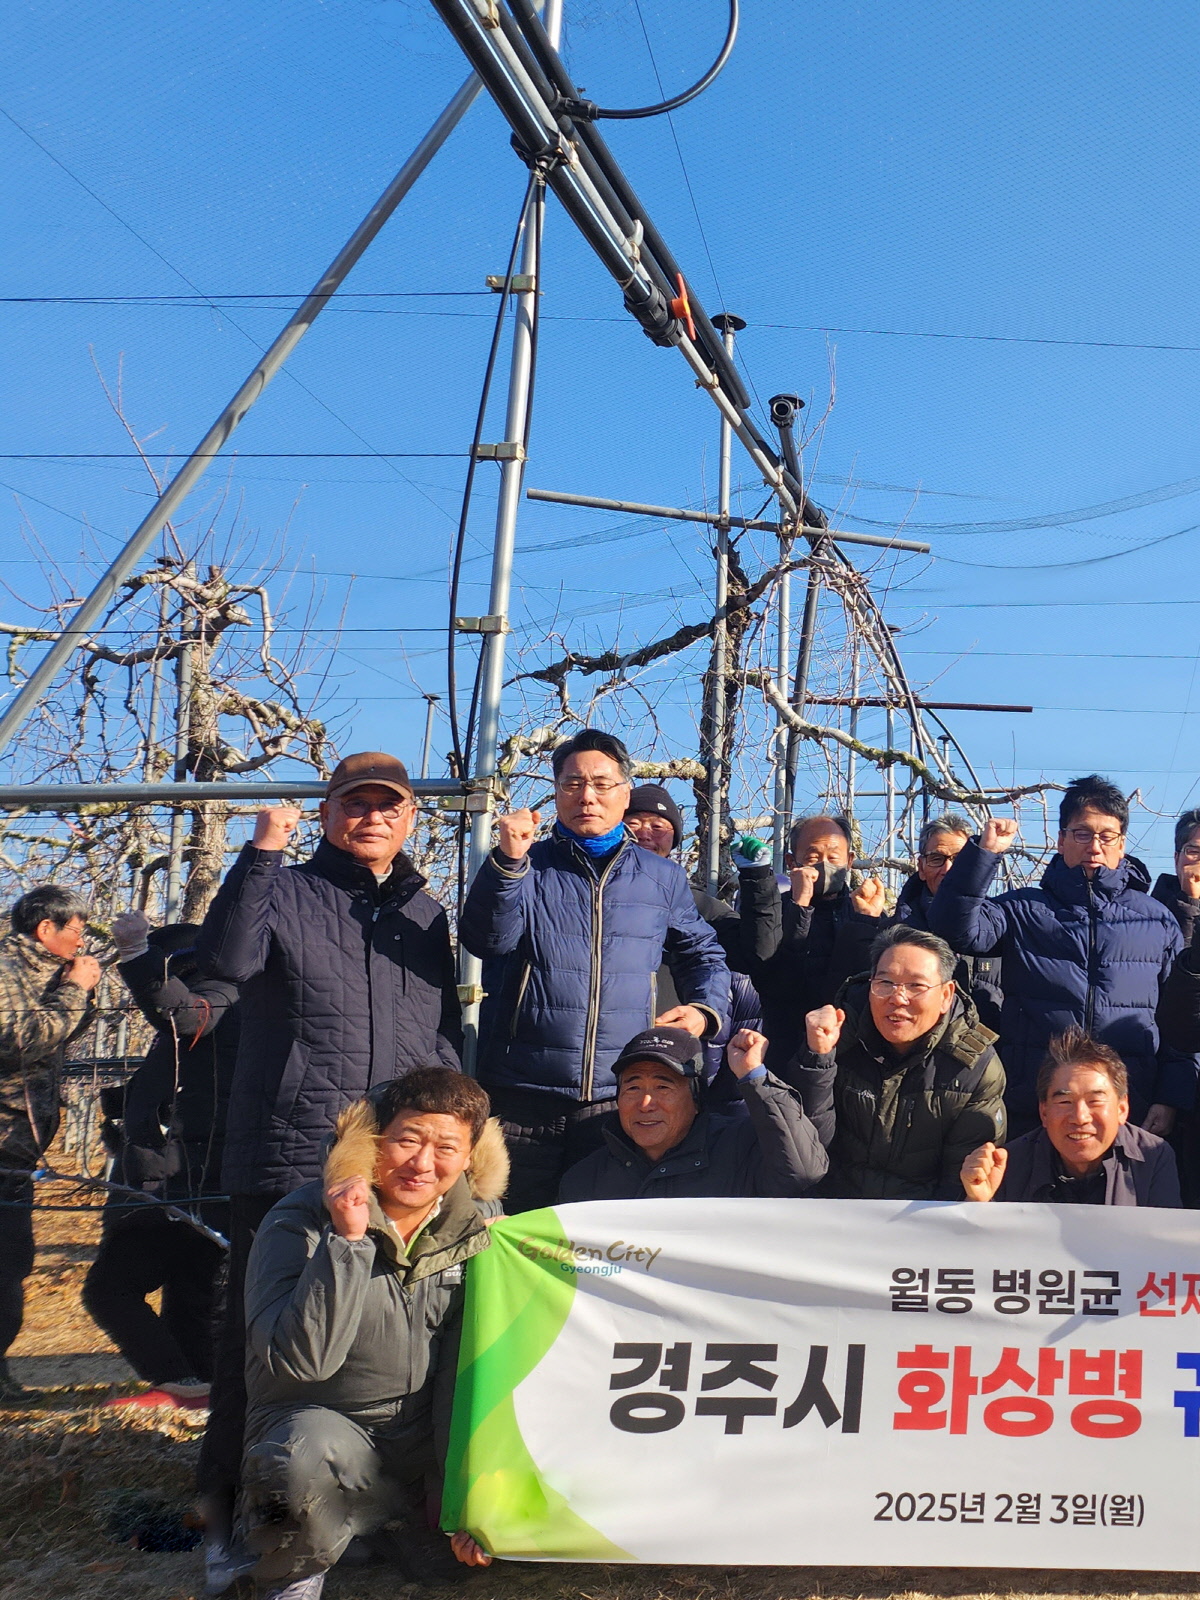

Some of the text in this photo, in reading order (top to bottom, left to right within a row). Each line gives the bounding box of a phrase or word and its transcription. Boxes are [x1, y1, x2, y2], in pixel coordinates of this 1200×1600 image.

[517, 1236, 662, 1272] Golden City
[560, 1262, 622, 1277] Gyeongju
[889, 1267, 976, 1314] 월동
[991, 1269, 1122, 1317] 병원균
[608, 1341, 867, 1436] 경주시
[892, 1343, 1144, 1440] 화상병
[873, 1490, 1146, 1528] 2025년 2월 3일(월)
